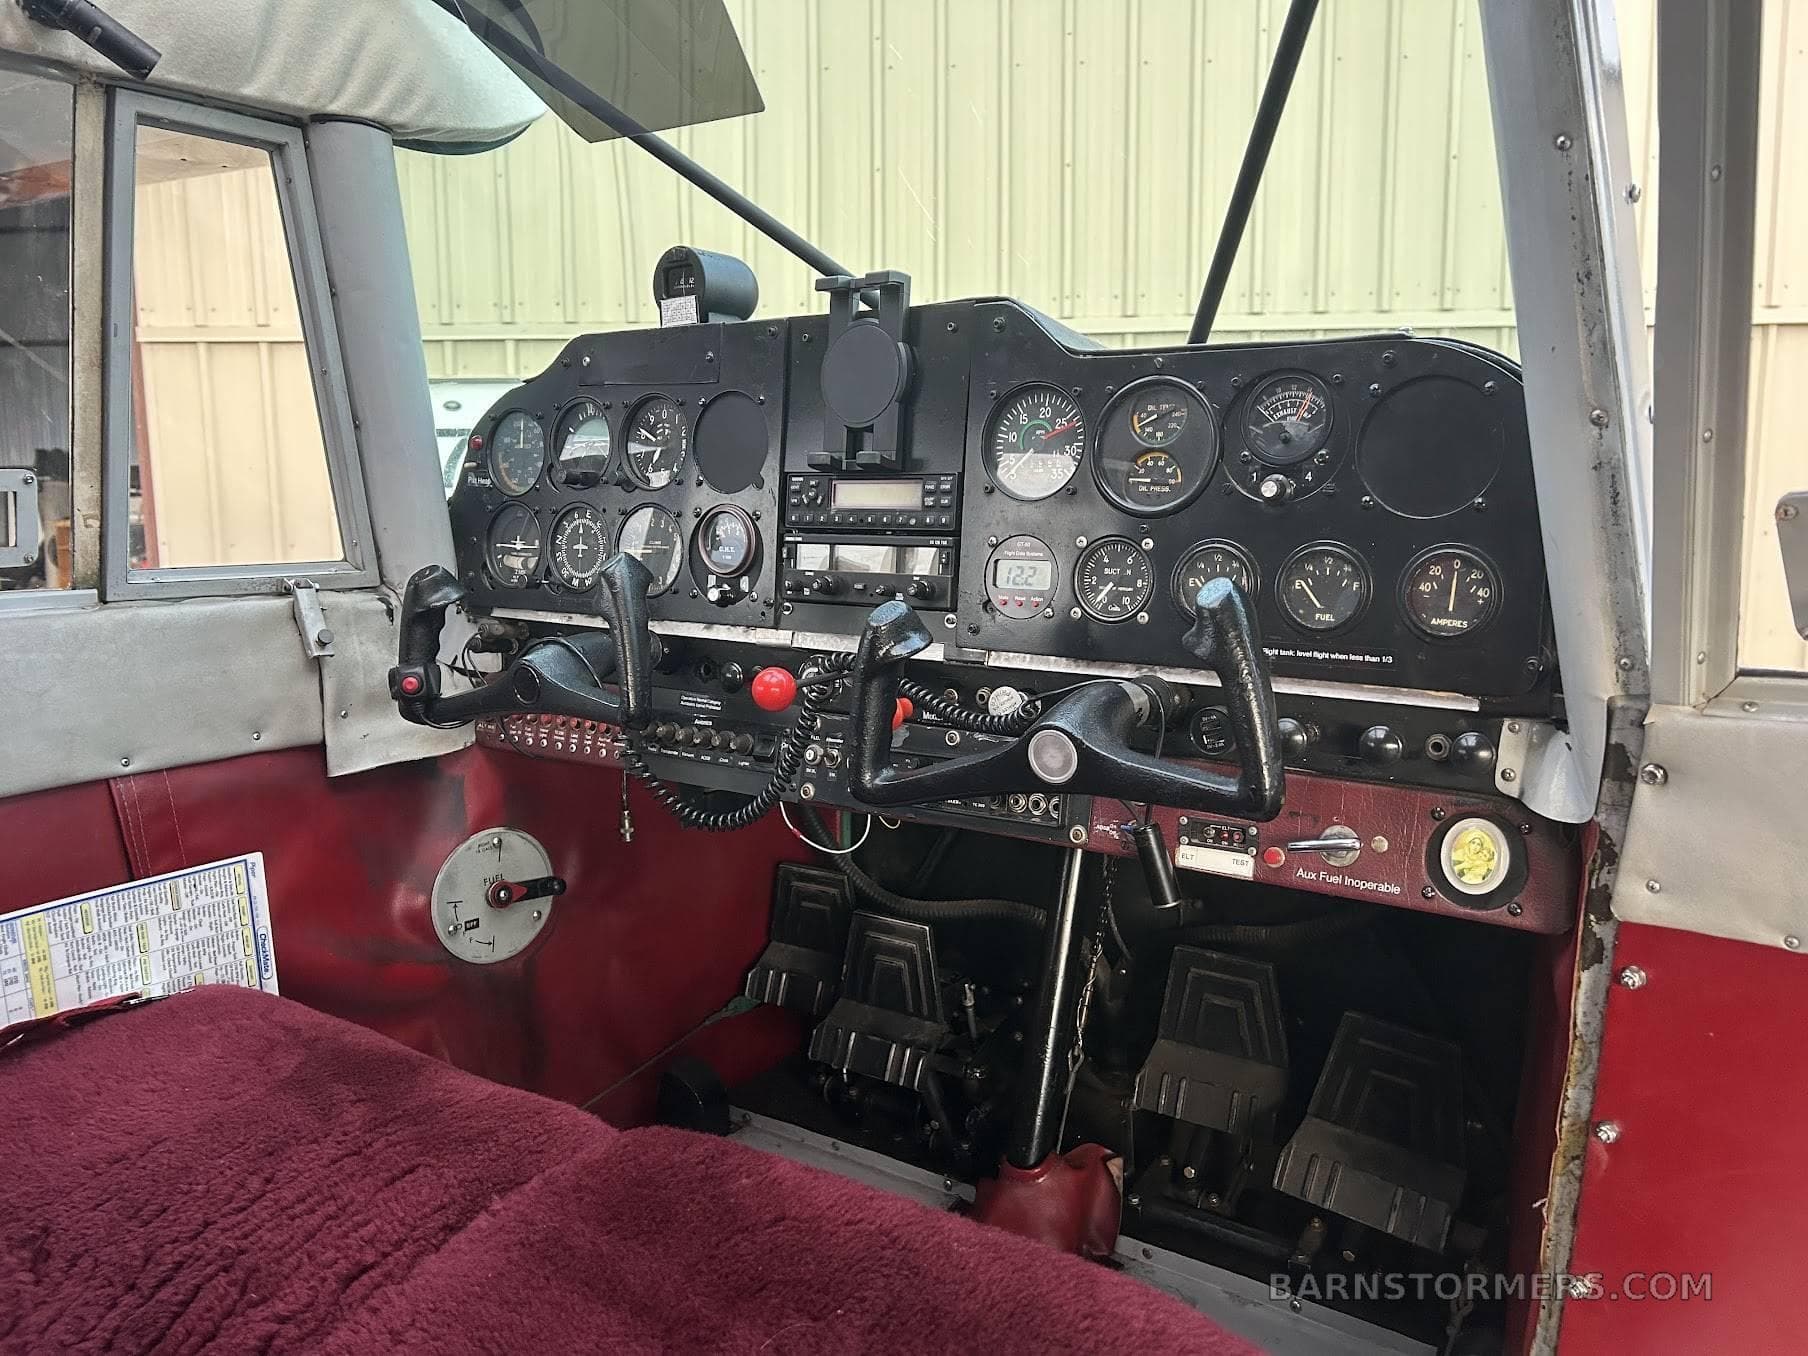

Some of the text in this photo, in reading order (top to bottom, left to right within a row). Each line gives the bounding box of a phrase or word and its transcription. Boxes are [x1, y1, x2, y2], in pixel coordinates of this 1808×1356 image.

[662, 409, 667, 419] 0
[1039, 407, 1052, 418] 20
[649, 415, 655, 425] 9
[1019, 414, 1028, 425] 15
[1055, 418, 1068, 429] 25
[681, 426, 686, 437] 2
[1008, 431, 1017, 442] 10
[1064, 445, 1077, 456] 30
[648, 463, 653, 473] 6
[1050, 468, 1063, 480] 35
[1251, 472, 1257, 482] 1
[1305, 471, 1313, 482] 4
[574, 511, 579, 519] 6
[585, 509, 592, 519] E
[556, 535, 563, 545] N
[1103, 555, 1109, 563] 4
[1127, 556, 1133, 564] 6
[1454, 559, 1460, 569] 0
[1104, 567, 1132, 575] SUCTN
[1429, 565, 1441, 576] 20
[1471, 569, 1483, 579] 20
[1092, 576, 1097, 585] 2
[1136, 579, 1142, 587] 8
[1189, 577, 1195, 587] E
[1295, 580, 1302, 589] E
[1353, 582, 1360, 591] F
[1418, 582, 1431, 592] 40
[1477, 587, 1490, 598] 40
[1122, 596, 1130, 604] 10
[1315, 613, 1335, 621] FUEL
[1431, 617, 1468, 629] AMPERES
[1296, 649, 1312, 658] level
[1313, 651, 1329, 660] flight
[1349, 653, 1363, 661] less
[1364, 654, 1380, 662] than
[1382, 655, 1393, 663] 1/3
[1181, 853, 1249, 867] ELT TEST
[483, 873, 505, 886] FUEL
[1296, 867, 1401, 894] Aux Fuel Inoperable
